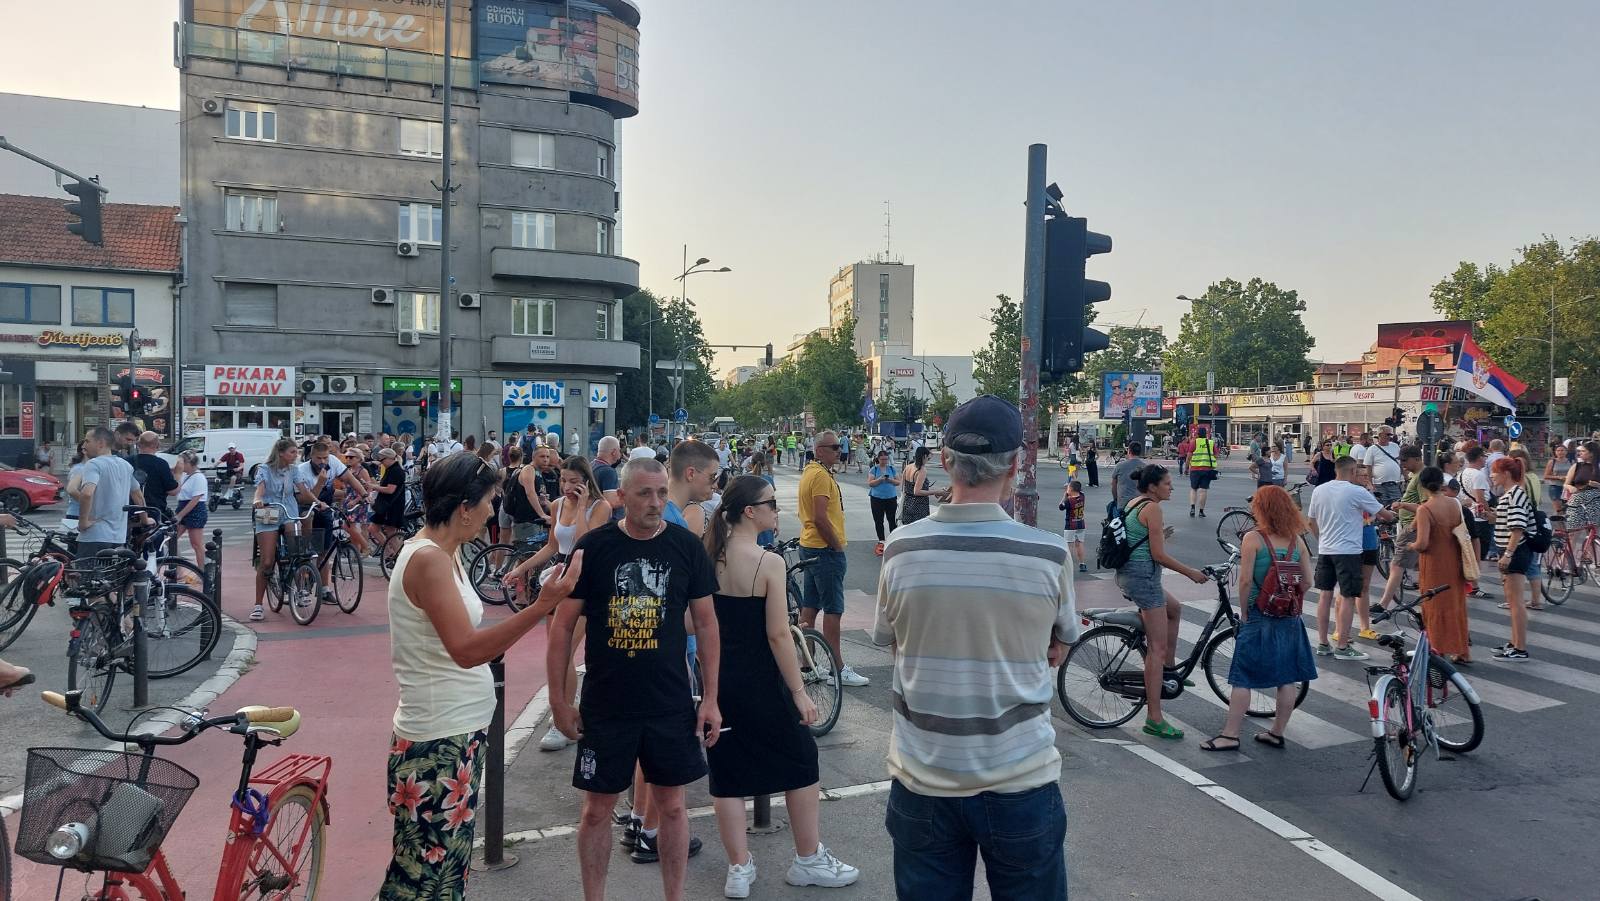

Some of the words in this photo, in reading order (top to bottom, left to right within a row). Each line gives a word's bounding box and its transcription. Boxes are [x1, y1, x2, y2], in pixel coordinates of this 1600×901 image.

[487, 13, 524, 25] BUDVI
[38, 330, 123, 347] Matijević
[214, 367, 287, 380] PEKARA
[898, 368, 913, 376] MAXI
[218, 382, 282, 395] DUNAV
[531, 384, 560, 404] lilly
[1421, 386, 1439, 401] BIG
